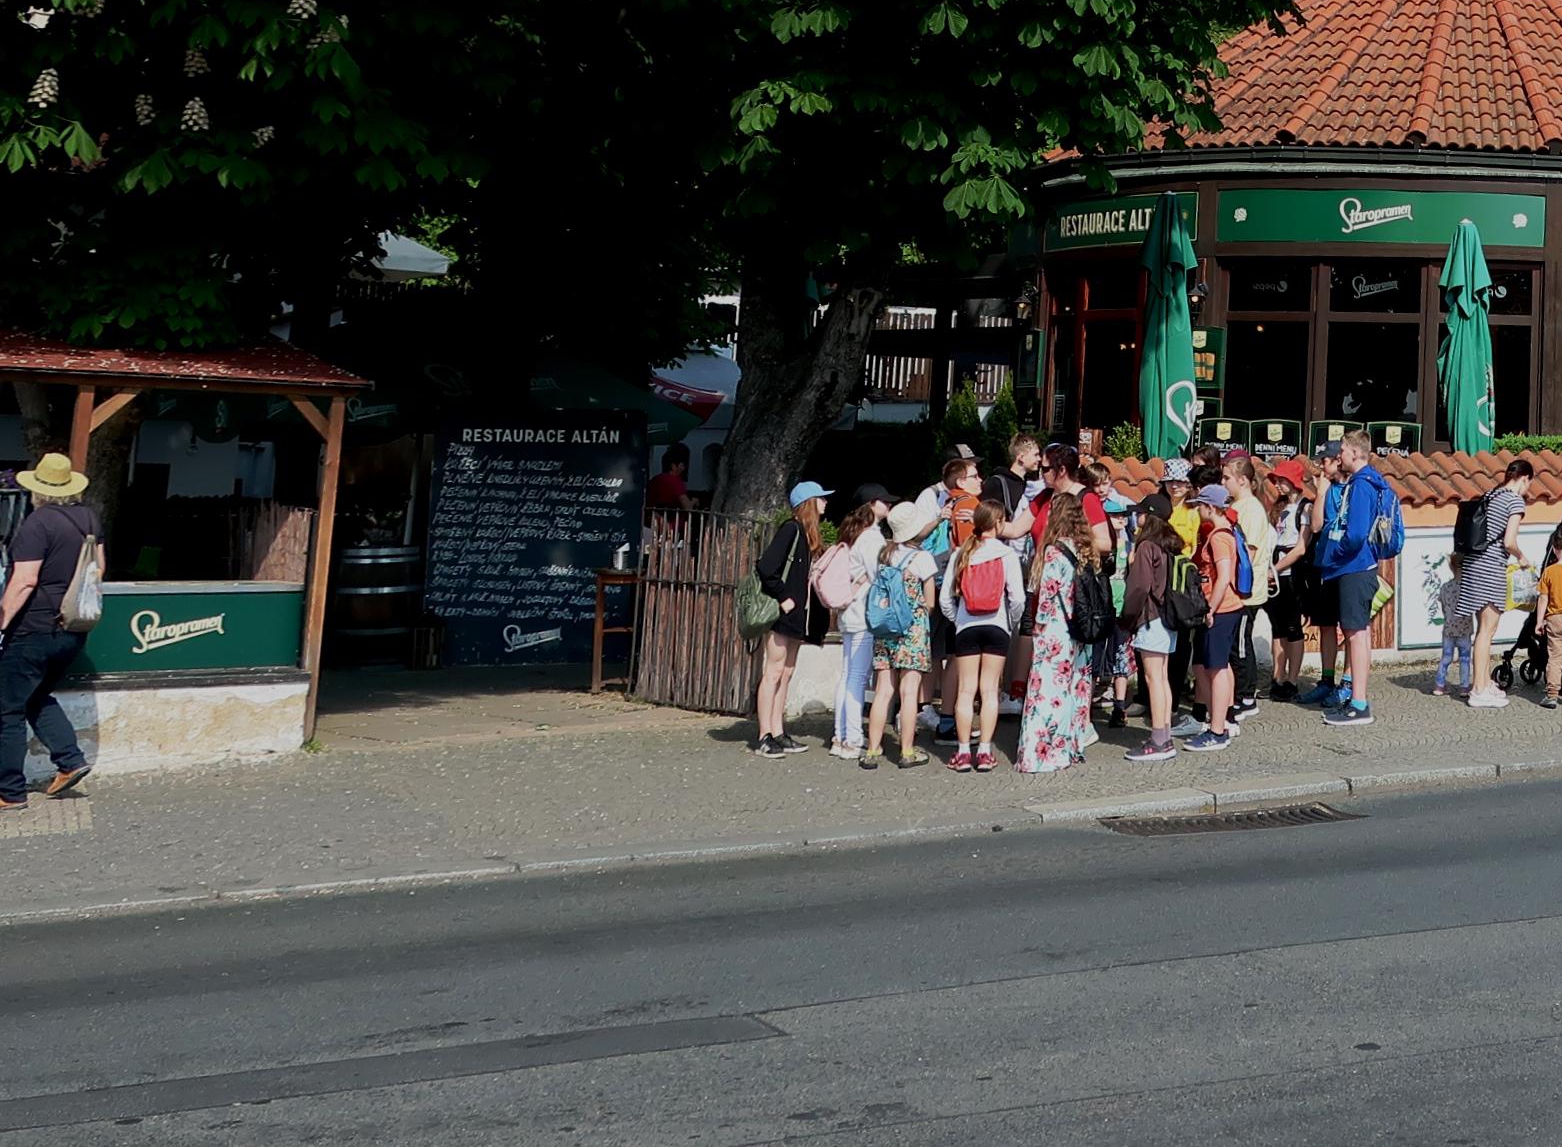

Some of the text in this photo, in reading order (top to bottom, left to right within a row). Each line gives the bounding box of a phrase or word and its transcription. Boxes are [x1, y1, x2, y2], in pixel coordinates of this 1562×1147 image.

[1060, 205, 1156, 238] RESTAURACE ALT
[1340, 198, 1414, 233] Staropramen
[462, 425, 621, 444] RESTAURACE ALTÁN
[130, 610, 226, 654] Staropramen
